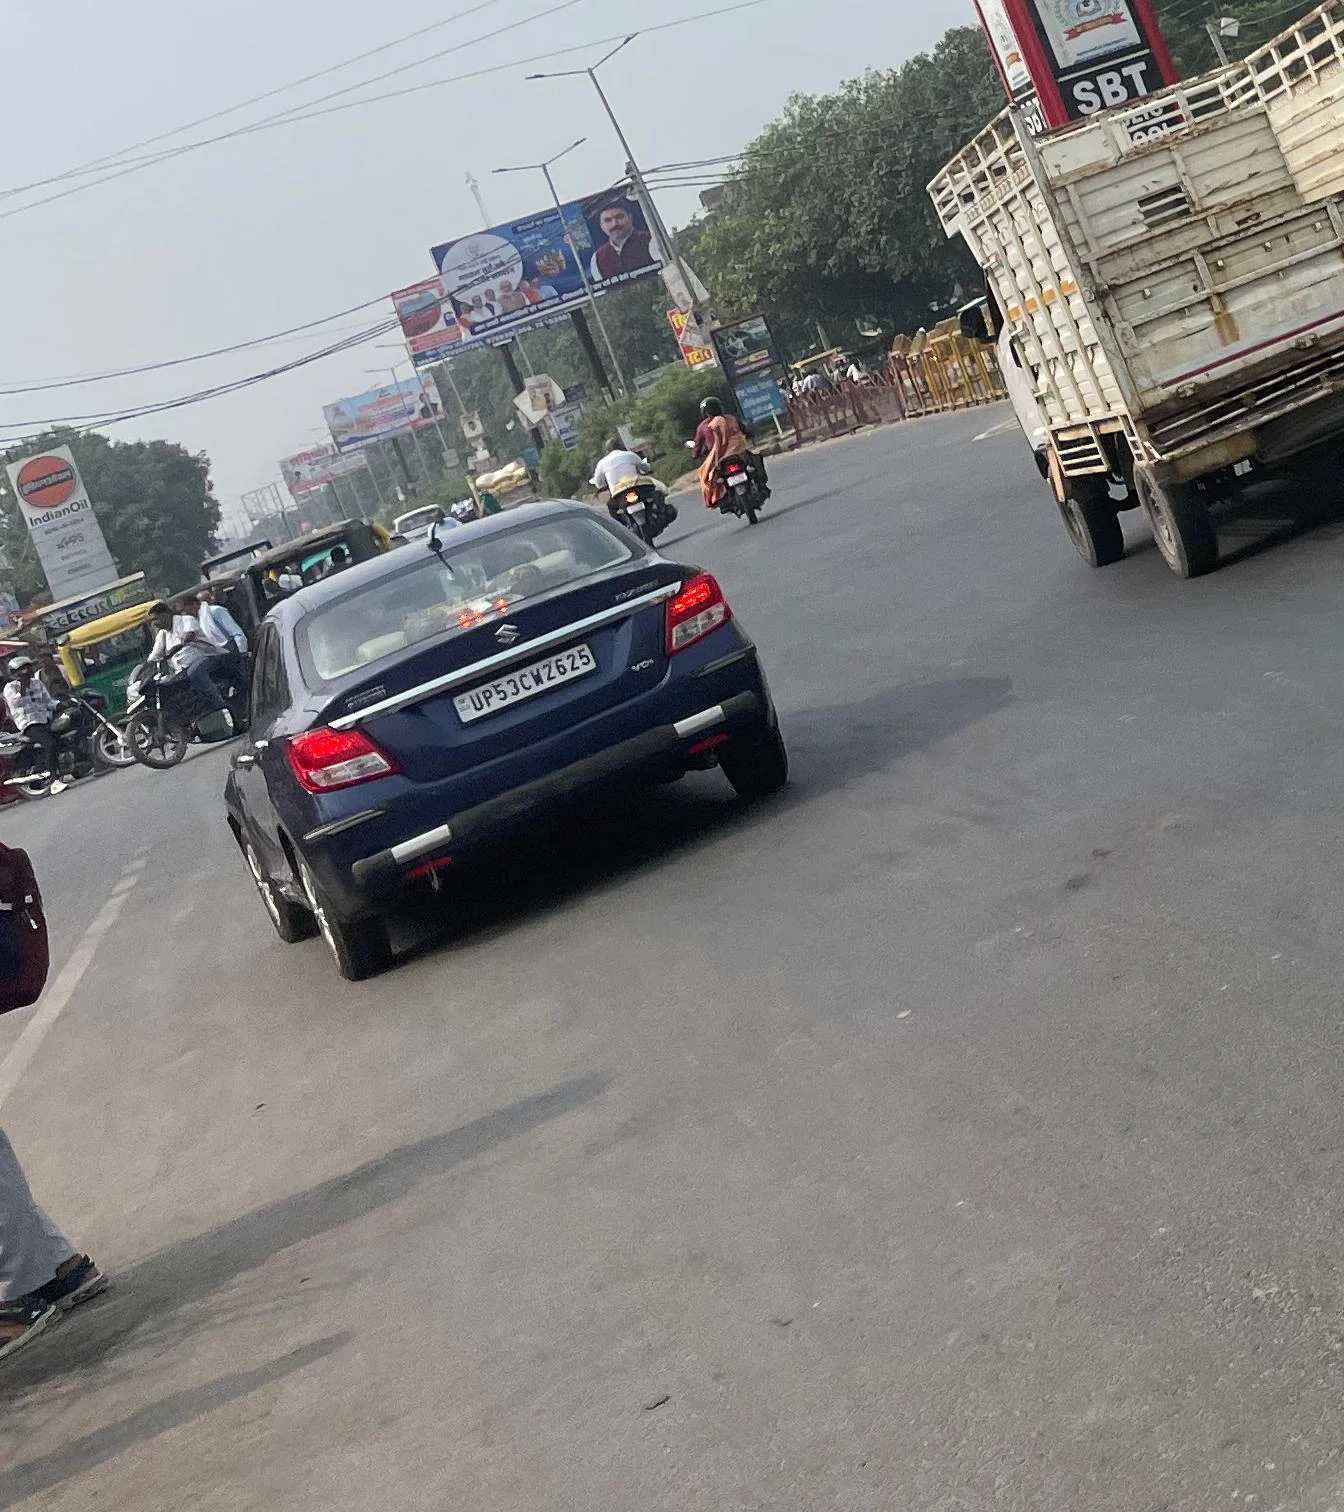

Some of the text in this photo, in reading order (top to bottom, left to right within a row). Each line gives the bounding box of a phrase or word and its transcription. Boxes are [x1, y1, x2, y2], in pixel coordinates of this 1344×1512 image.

[1072, 61, 1147, 115] SBT
[29, 498, 89, 527] IndianOil
[468, 647, 591, 712] UP53CW2625
